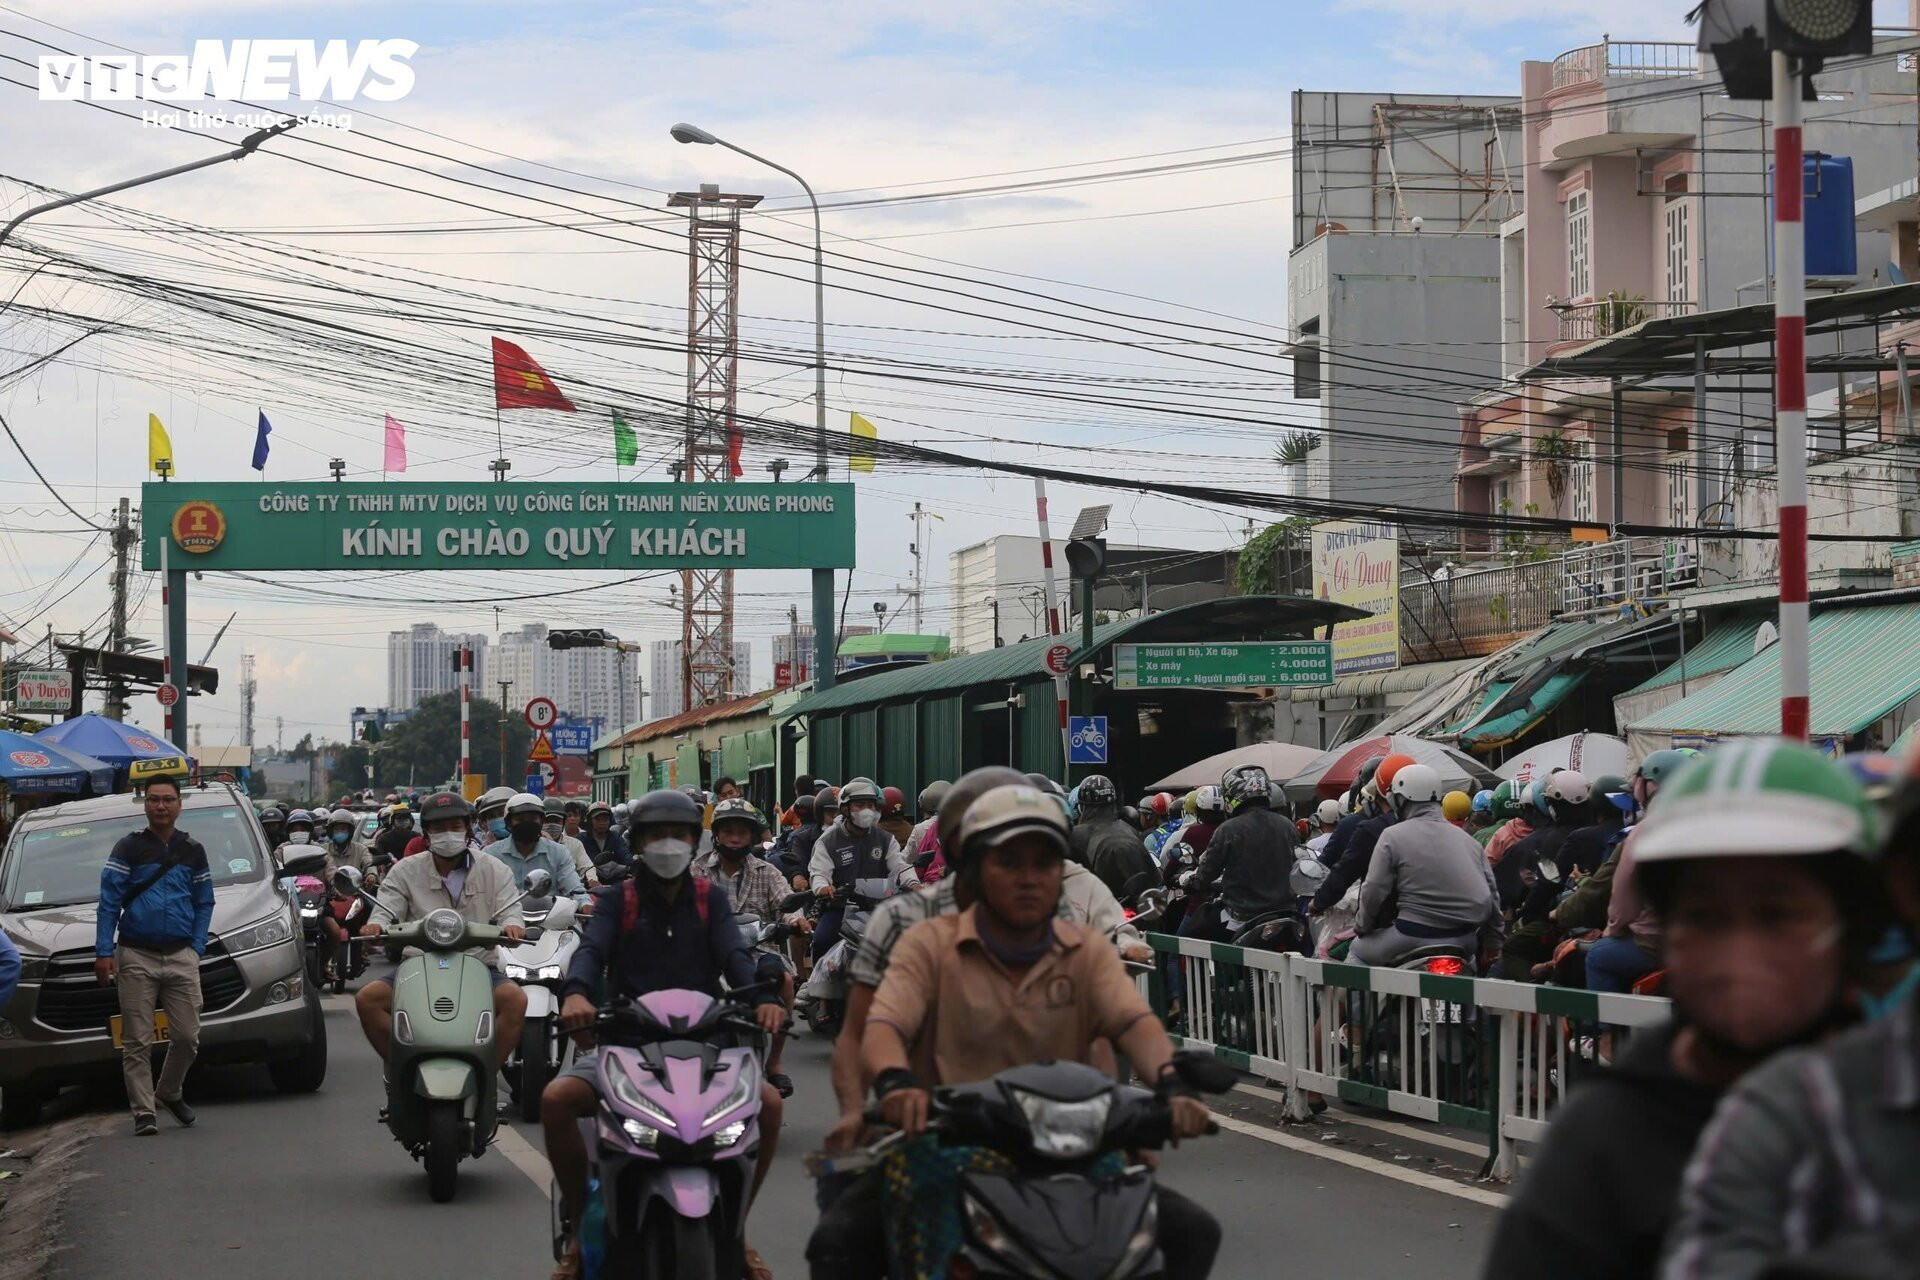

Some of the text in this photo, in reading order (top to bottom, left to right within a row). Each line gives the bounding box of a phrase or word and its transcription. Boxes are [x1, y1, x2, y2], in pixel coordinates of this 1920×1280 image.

[259, 489, 834, 516] CÔNG TY TNHH MTV DỊCH VỤ CÔNG ÍCH THANH NIÊN XUNG PHONG
[342, 519, 747, 561] KÍNH CHÀO QUÝ KHÁCH
[1354, 551, 1392, 591] Dung
[1145, 647, 1174, 658] Người
[1176, 647, 1186, 656] đi
[1188, 647, 1203, 658] bộ,
[1206, 647, 1218, 656] Xe
[1221, 647, 1238, 657] đạp
[1279, 646, 1326, 655] 2.000đ
[1146, 661, 1158, 670] Xe
[1161, 661, 1181, 671] máy
[1279, 659, 1327, 668] 4.000đ
[1146, 675, 1159, 684] Xe
[1161, 675, 1182, 685] máy
[1194, 674, 1222, 684] Người
[1225, 673, 1246, 683] ngồi
[1248, 674, 1266, 683] sau
[1280, 672, 1327, 681] 6.000đ
[162, 686, 173, 704] STOP
